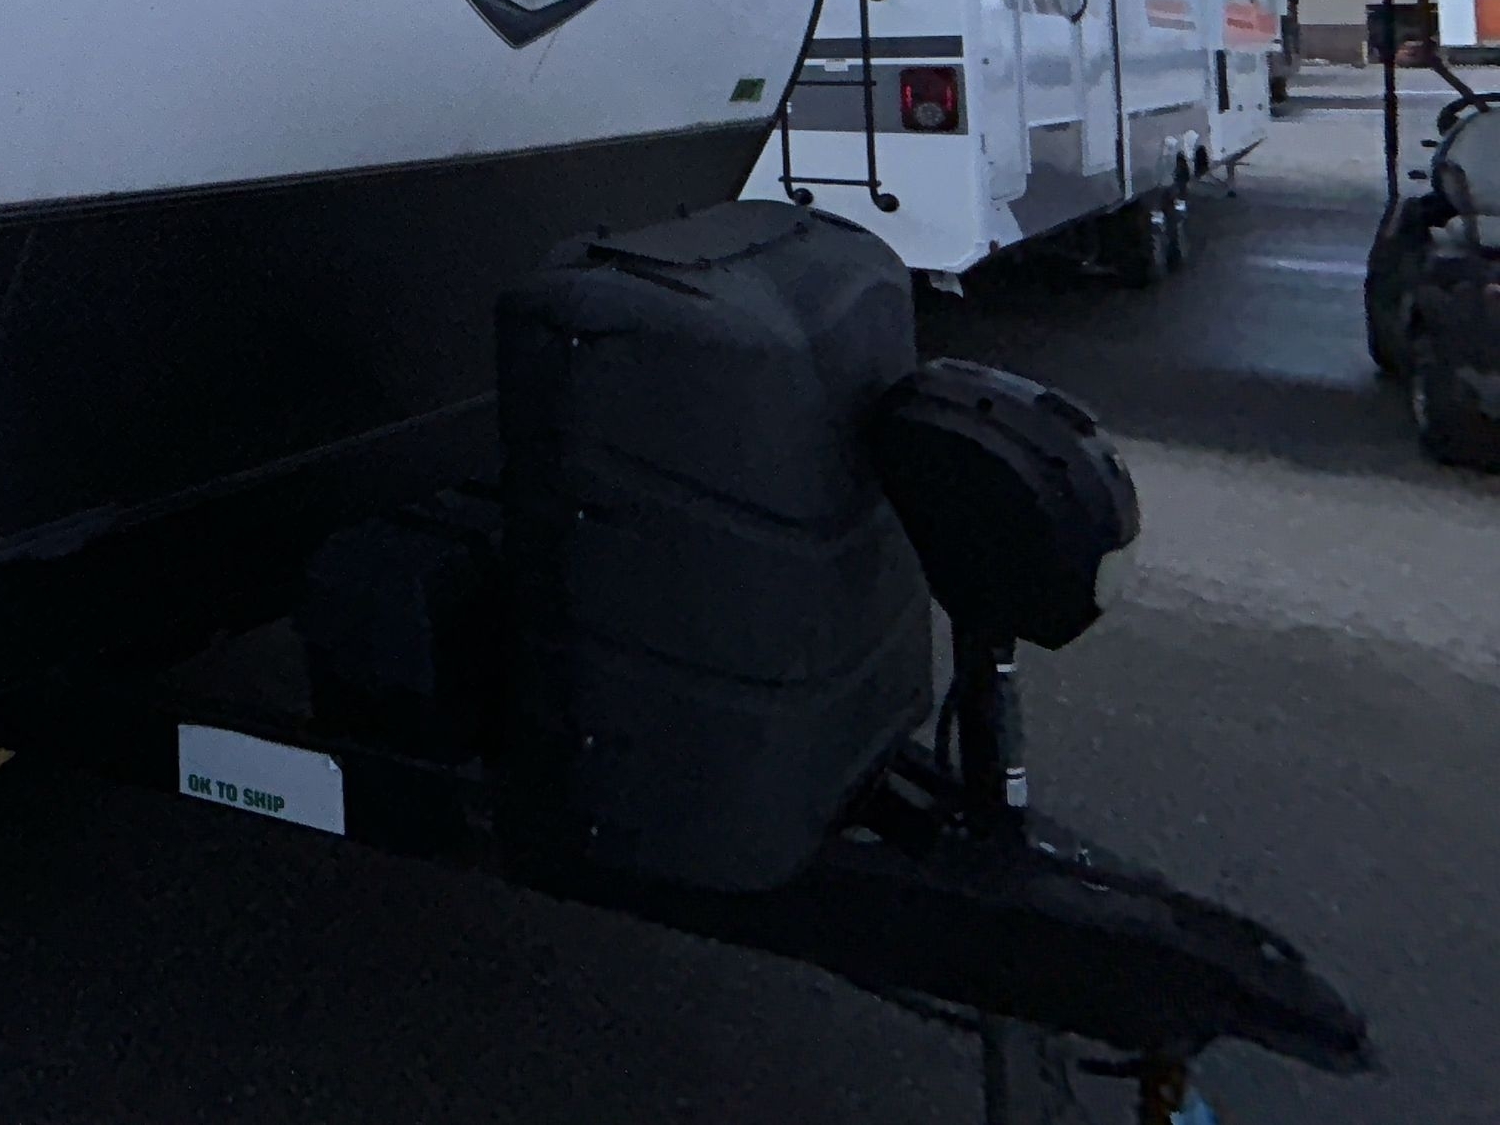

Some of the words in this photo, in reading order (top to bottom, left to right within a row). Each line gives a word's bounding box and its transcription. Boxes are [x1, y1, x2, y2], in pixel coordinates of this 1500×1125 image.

[188, 774, 212, 796] OK
[216, 780, 237, 802] TO
[243, 788, 285, 813] SHIP
